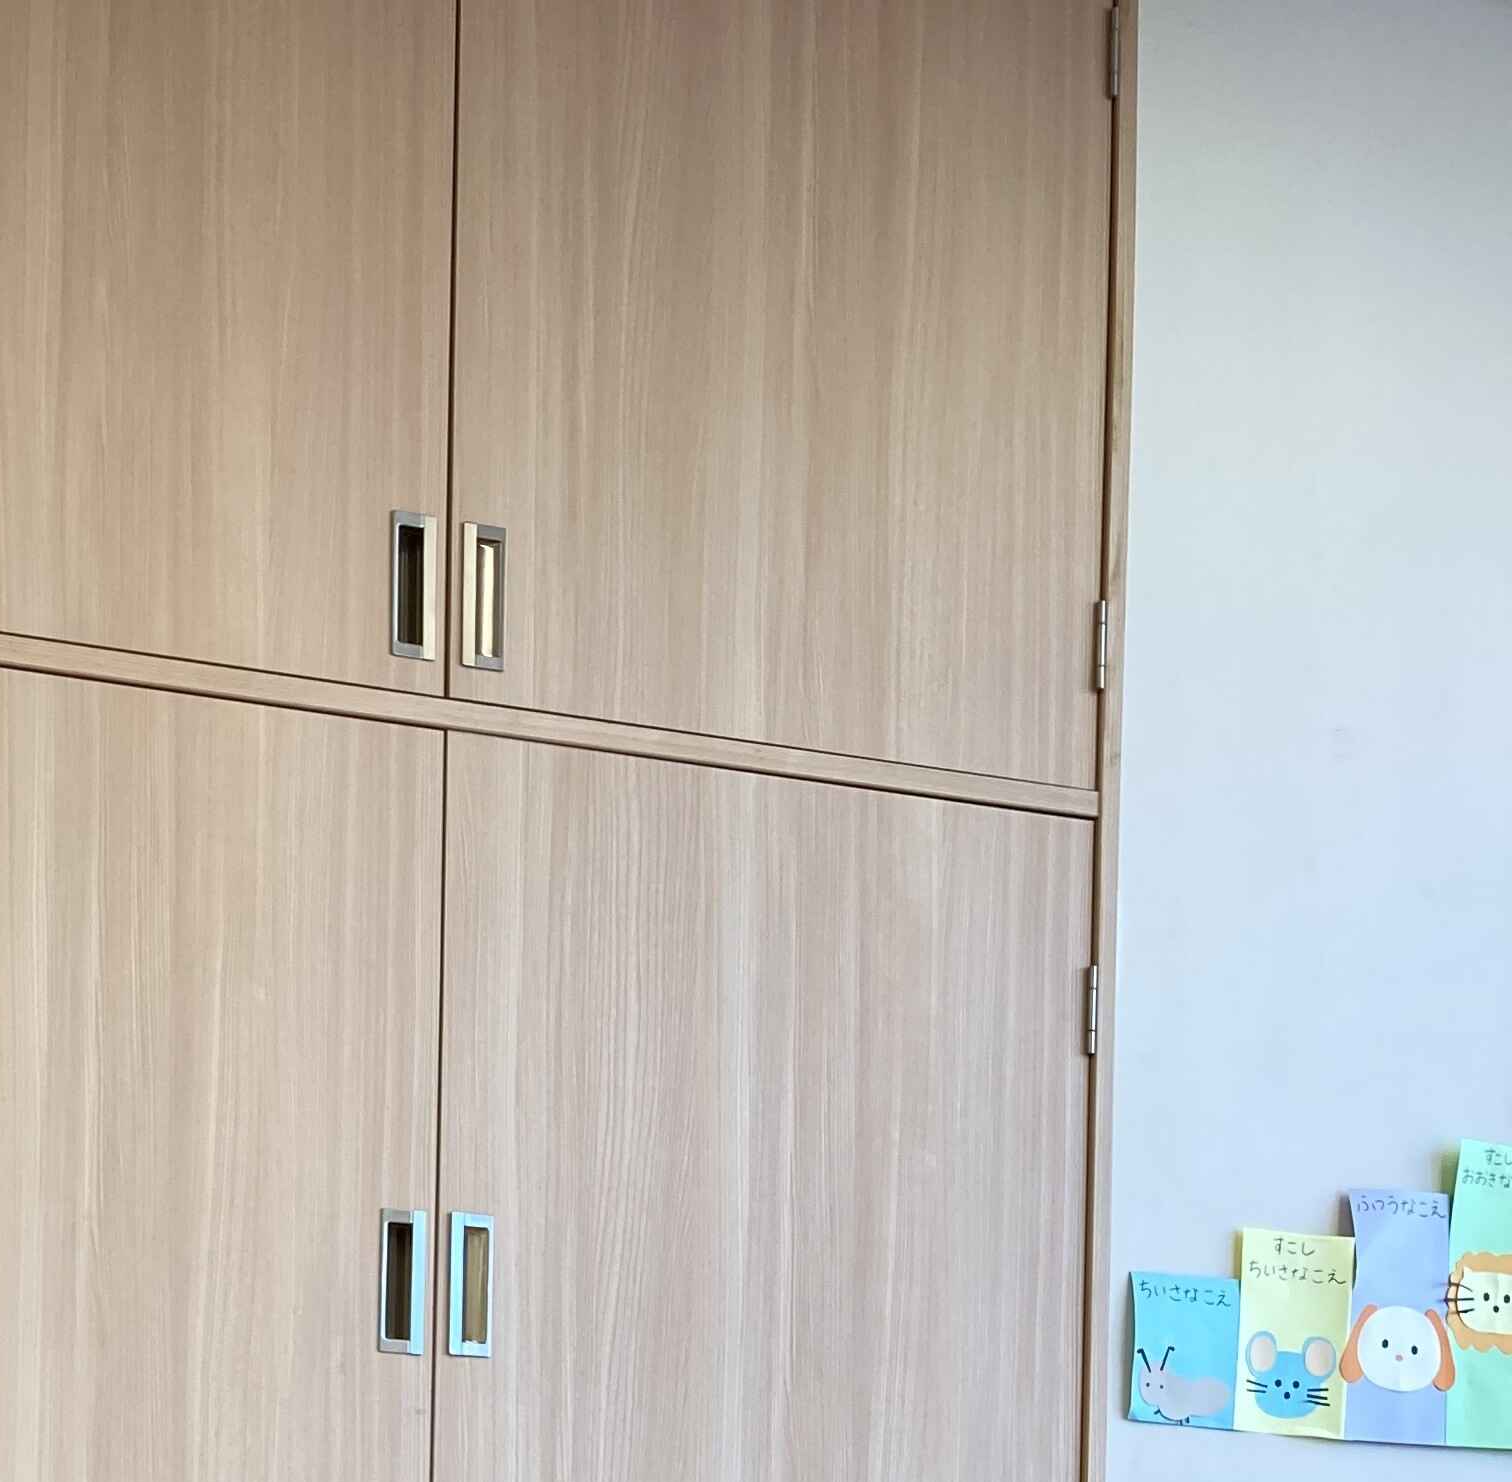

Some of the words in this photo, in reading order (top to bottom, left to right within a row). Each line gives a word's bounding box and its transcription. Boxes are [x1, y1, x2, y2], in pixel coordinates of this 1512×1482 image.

[1273, 1237, 1316, 1257] すこし
[1248, 1260, 1347, 1286] ちいさなこえ
[1138, 1279, 1232, 1307] ちいさなこえ
